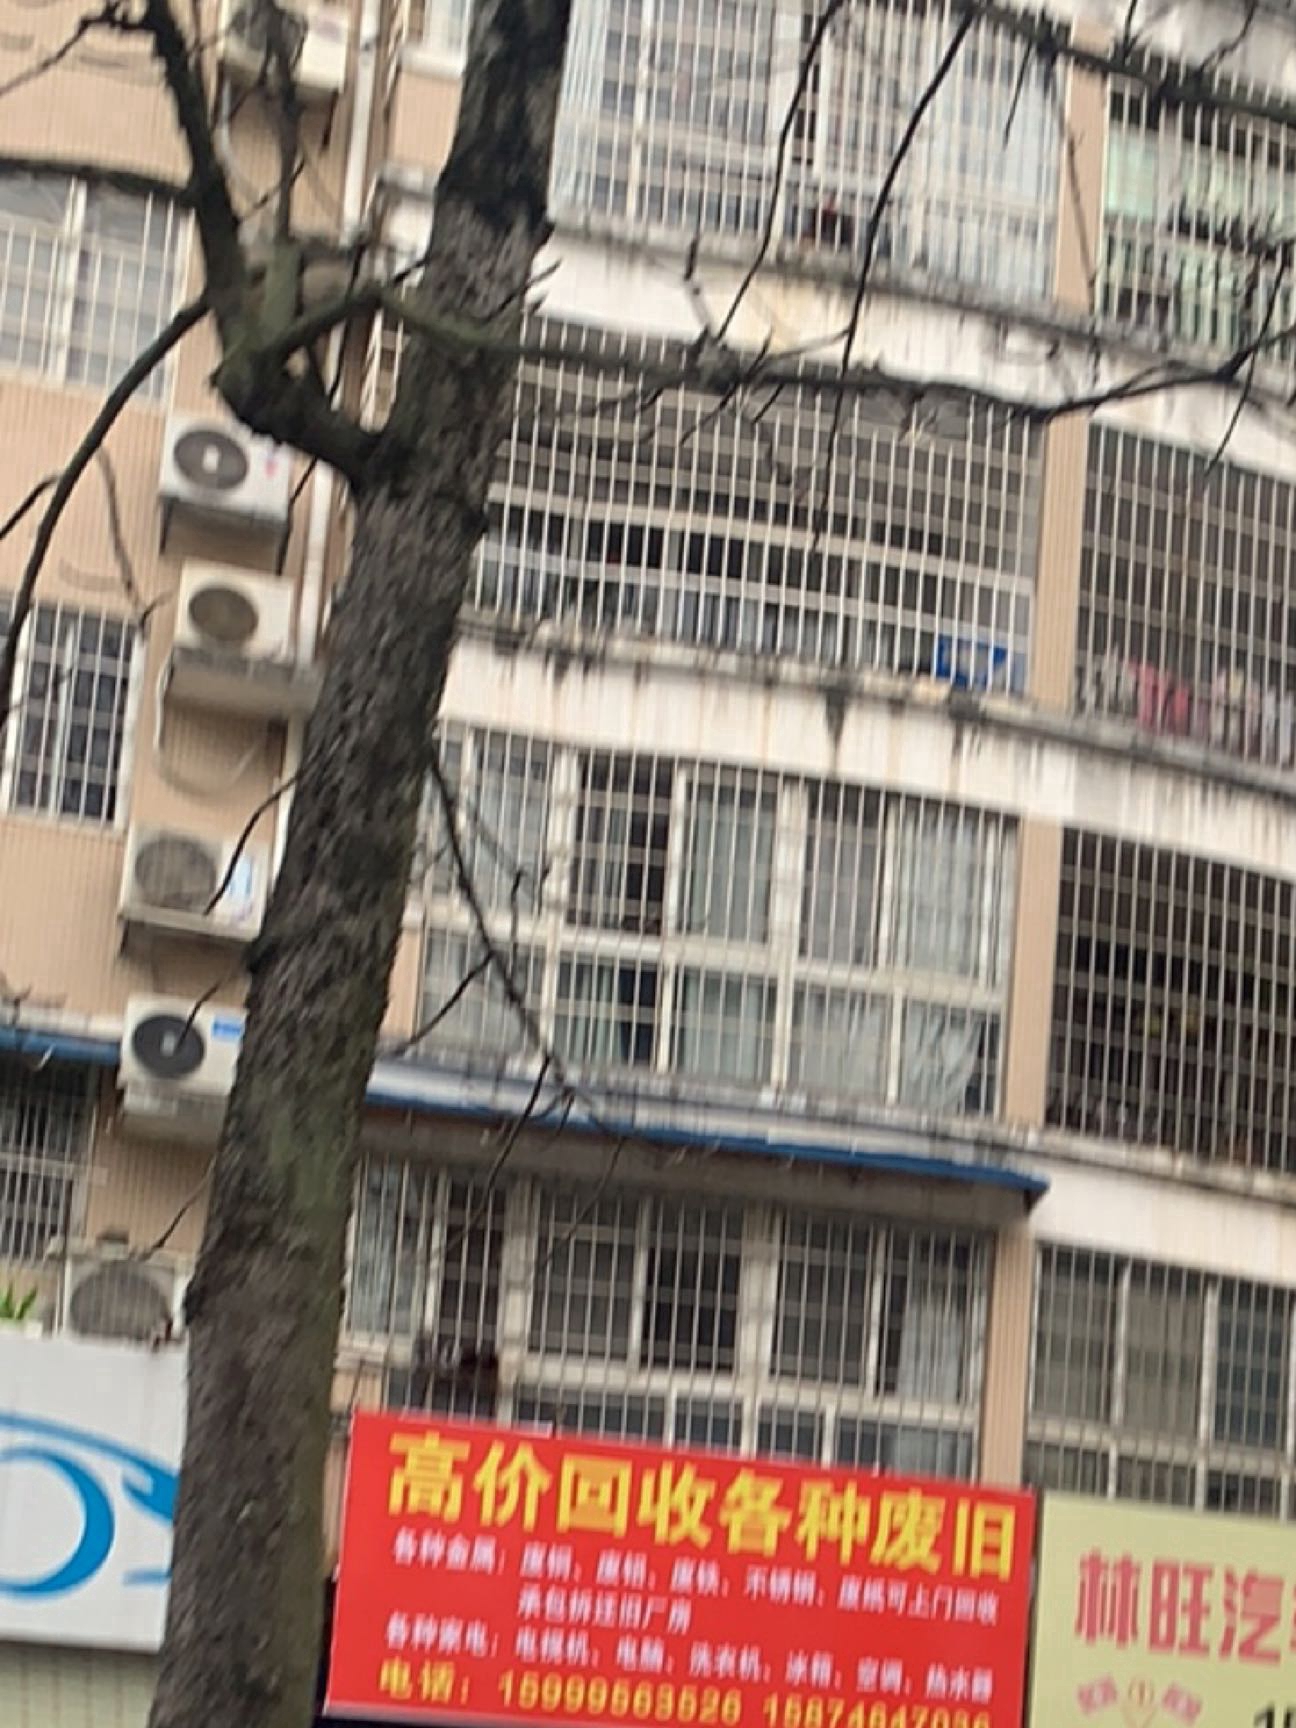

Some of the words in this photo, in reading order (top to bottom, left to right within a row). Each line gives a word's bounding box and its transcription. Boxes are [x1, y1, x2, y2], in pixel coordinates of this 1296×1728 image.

[388, 1431, 1015, 1582] 高价回收各种废旧
